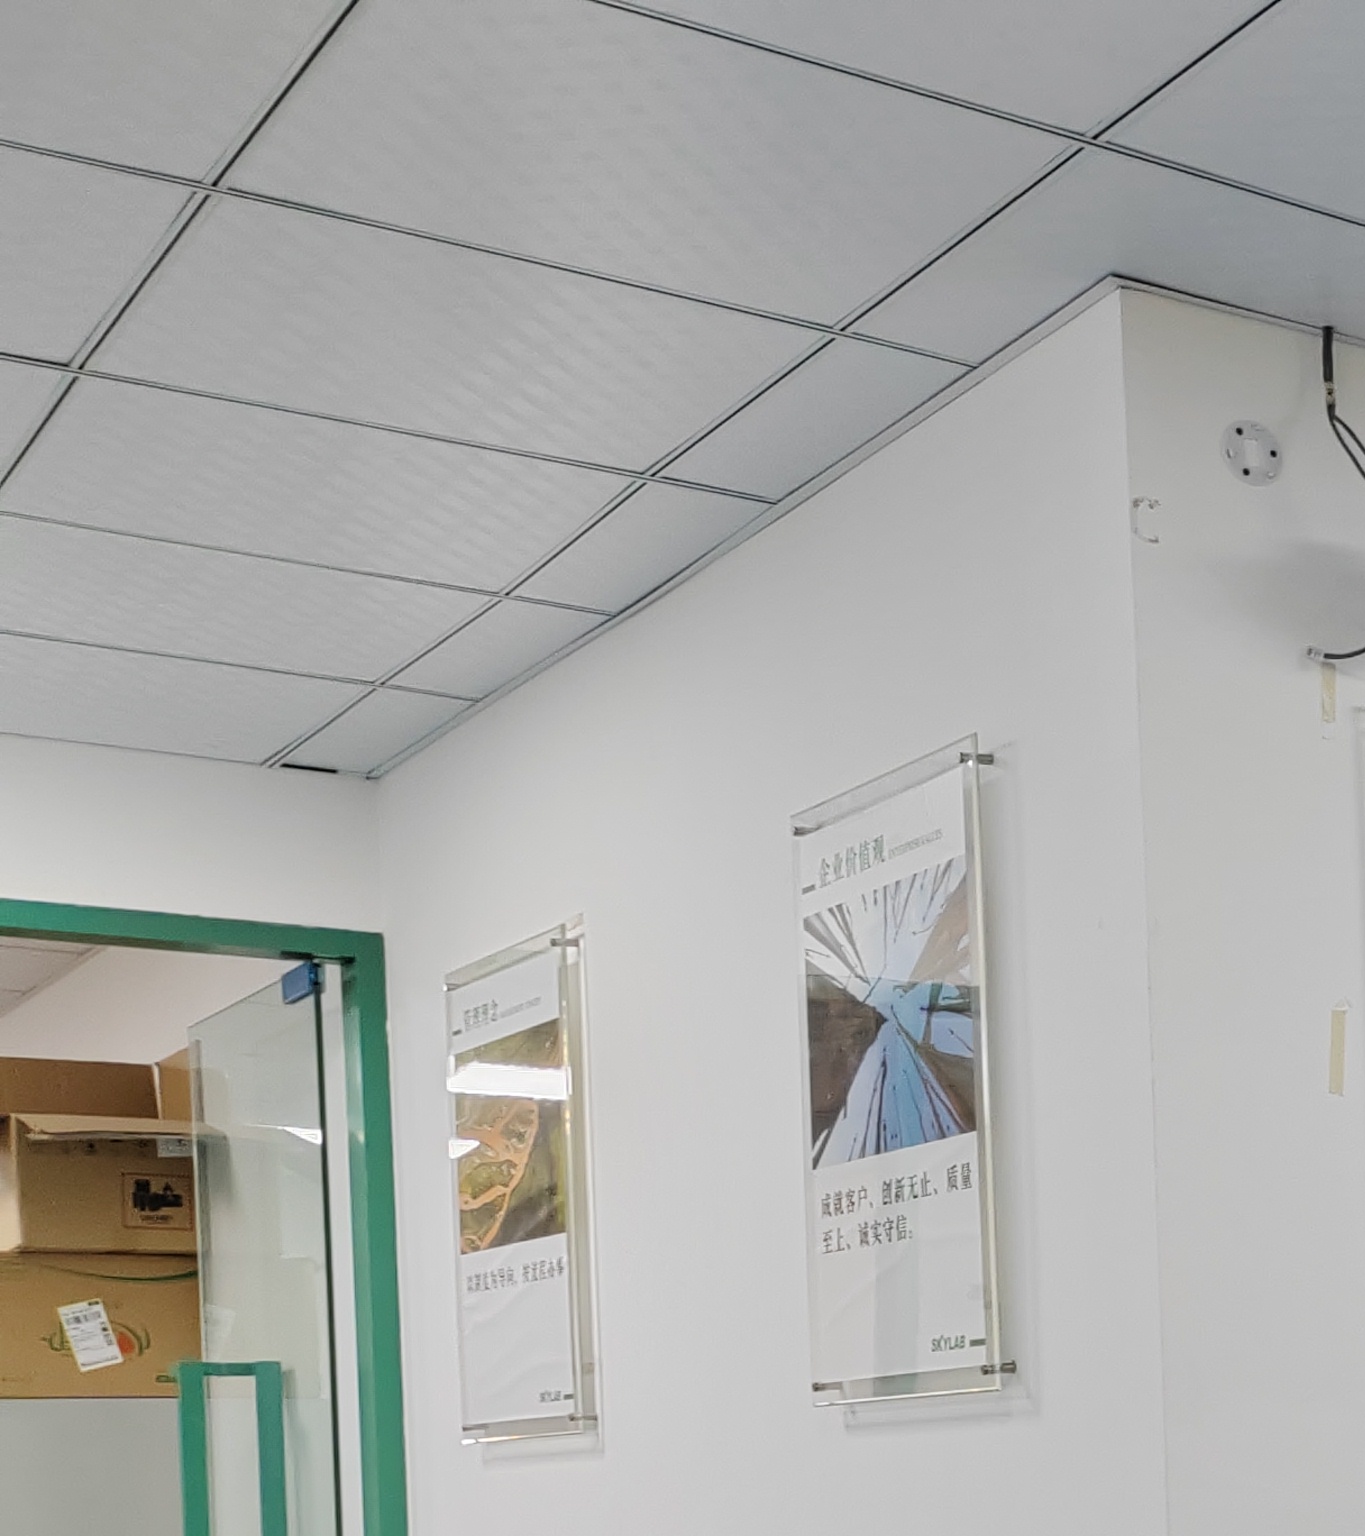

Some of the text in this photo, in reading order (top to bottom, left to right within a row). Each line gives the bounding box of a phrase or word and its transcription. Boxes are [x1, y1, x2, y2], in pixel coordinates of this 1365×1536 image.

[819, 834, 885, 889] 企业价值观
